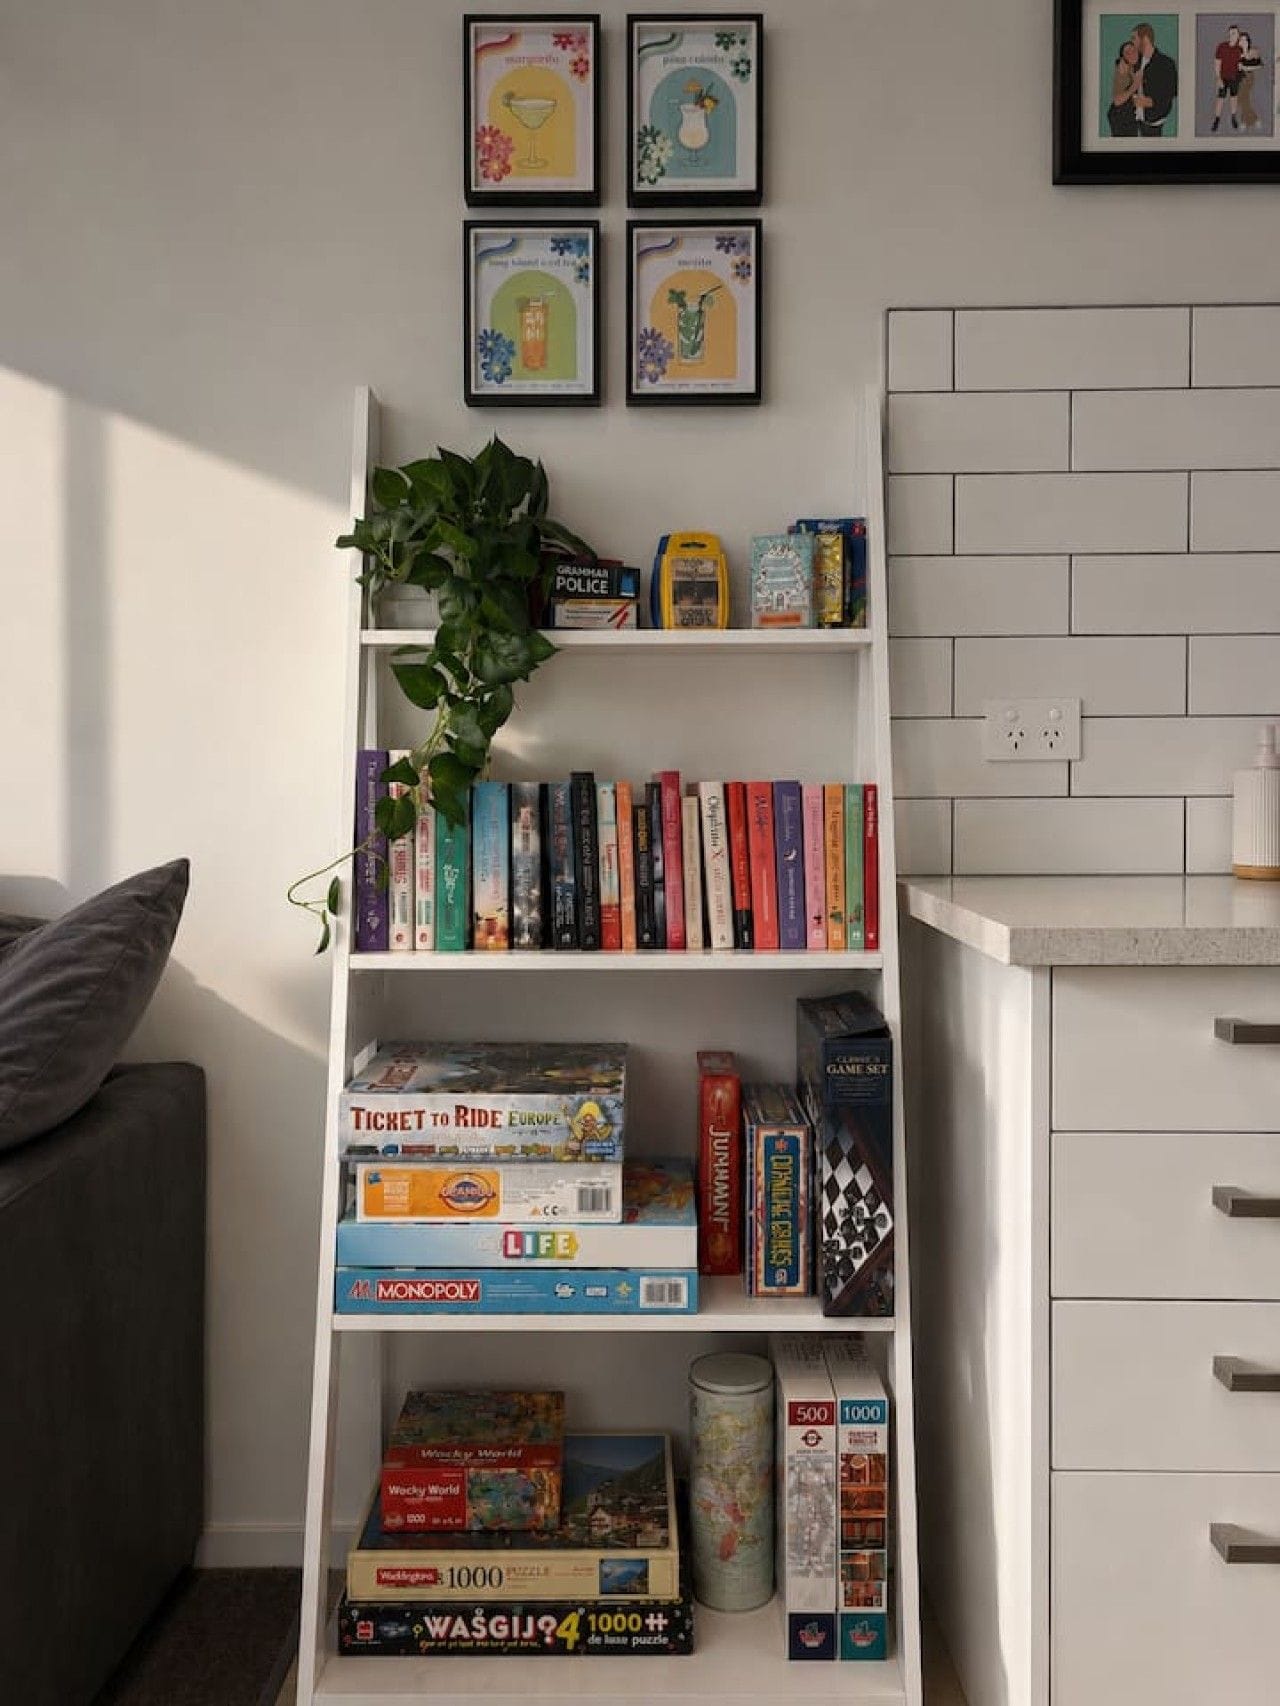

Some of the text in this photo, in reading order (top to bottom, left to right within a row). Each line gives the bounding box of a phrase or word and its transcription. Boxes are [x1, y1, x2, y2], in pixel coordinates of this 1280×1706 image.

[555, 564, 609, 578] GRAMMAR
[555, 576, 609, 595] POLICE
[826, 1063, 888, 1074] GAME SET
[350, 1104, 561, 1131] TICKET TO RIDE EUROPE
[506, 1234, 571, 1256] LIFE
[377, 1281, 479, 1299] MONOPOLY
[796, 1406, 828, 1422] 500
[844, 1405, 881, 1421] 1000
[388, 1483, 460, 1497] Wacky World
[447, 1565, 503, 1590] 1000
[556, 1611, 581, 1650] 4
[587, 1613, 643, 1632] 1000
[632, 1634, 669, 1648] puzzle
